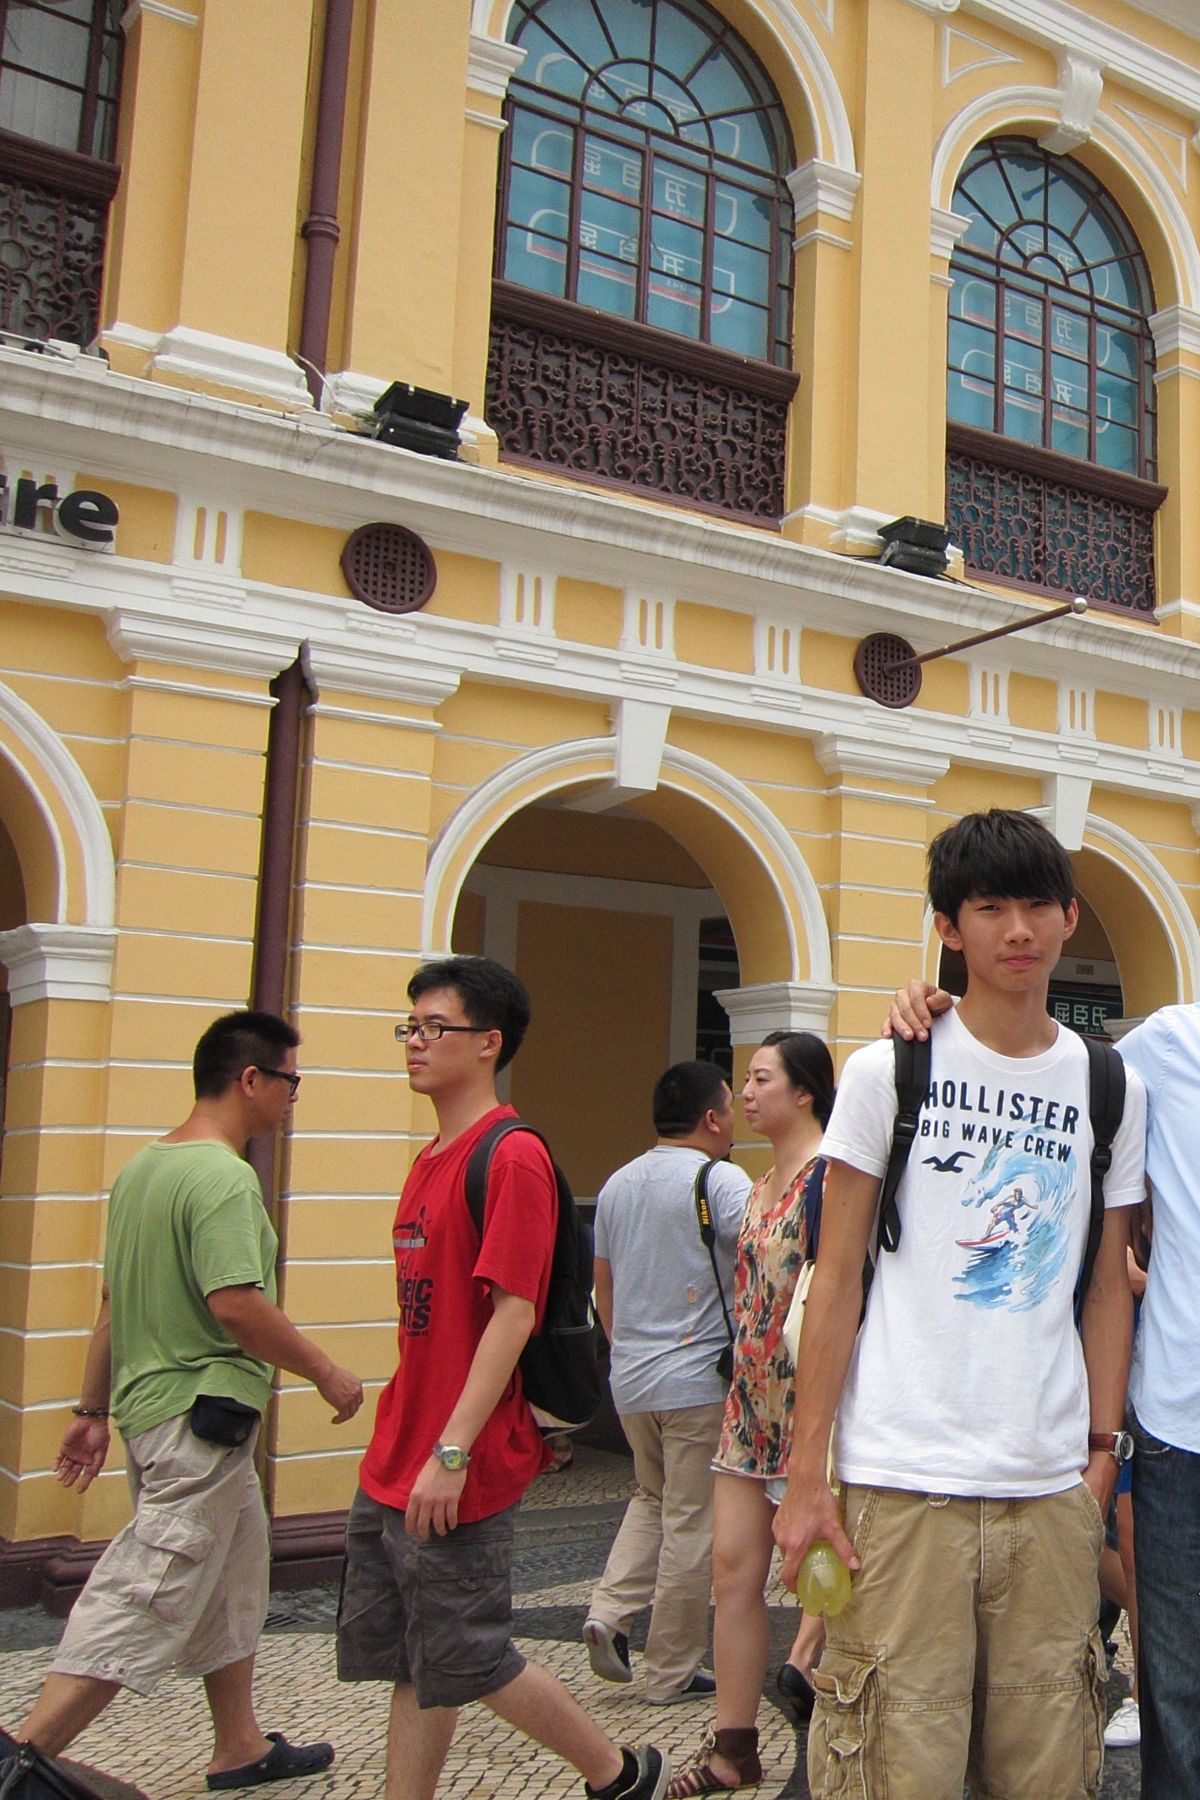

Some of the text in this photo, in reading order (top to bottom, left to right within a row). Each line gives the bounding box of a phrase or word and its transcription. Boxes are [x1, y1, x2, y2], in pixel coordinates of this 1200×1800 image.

[924, 1080, 1079, 1134] HOLLISTER
[921, 1119, 1072, 1162] BIG WAVE CREW
